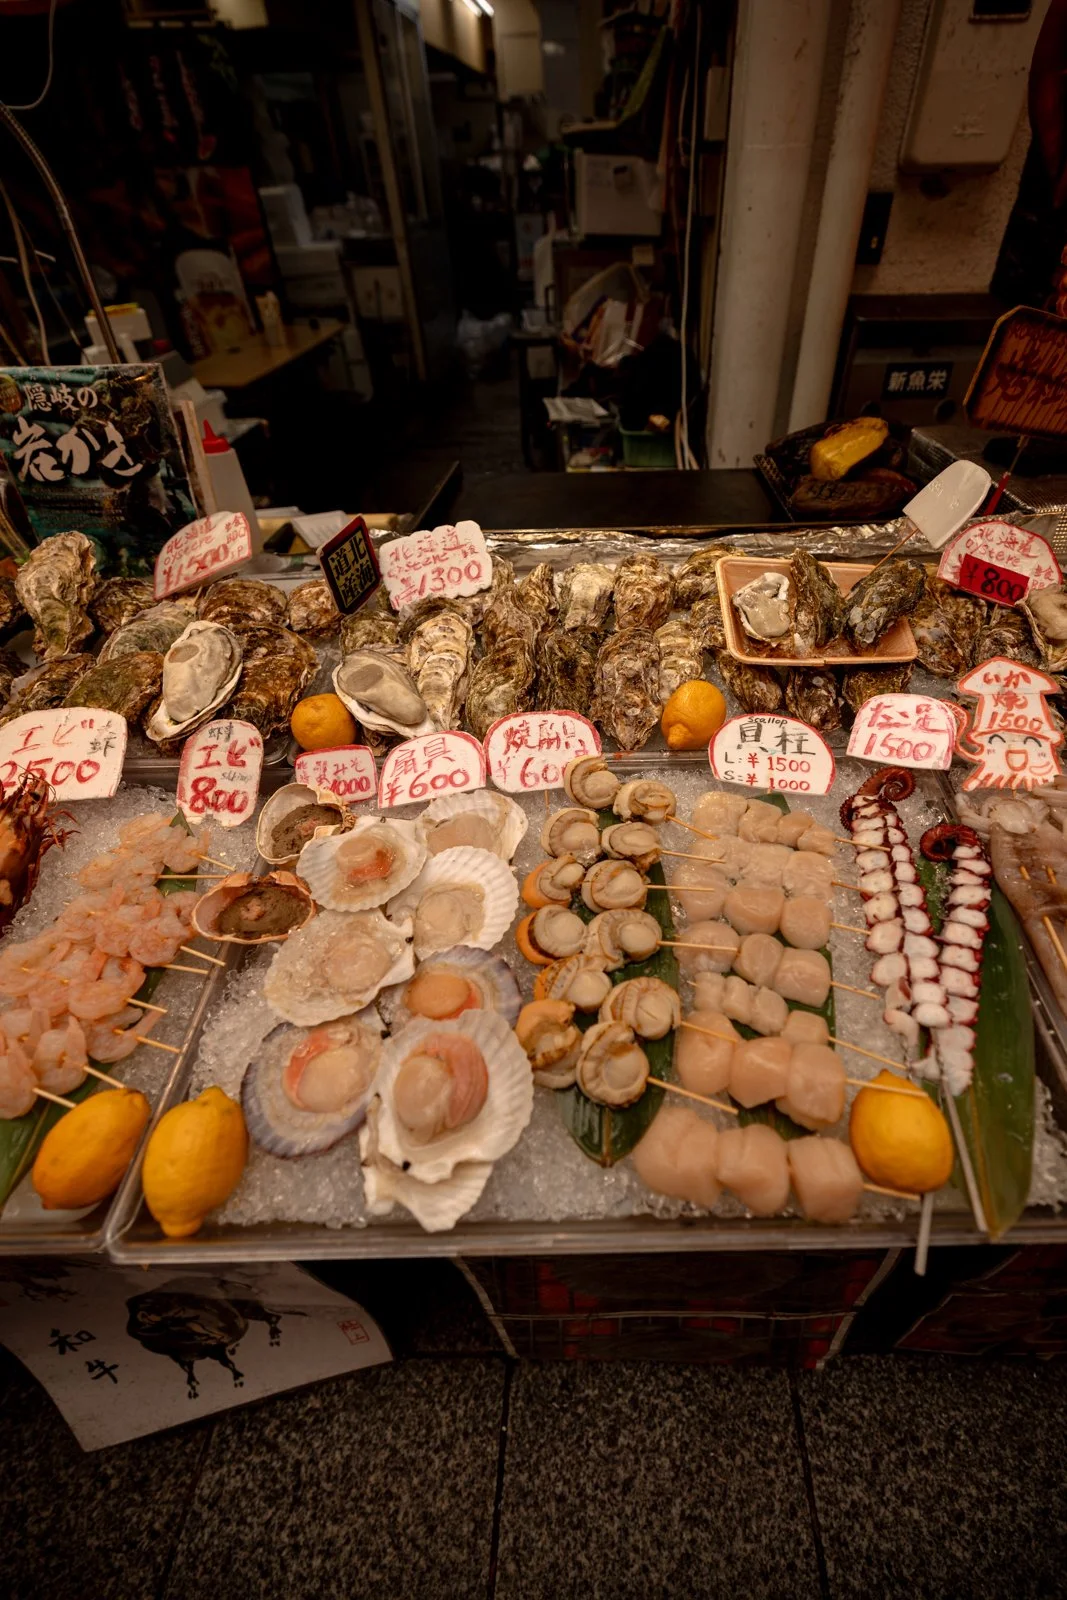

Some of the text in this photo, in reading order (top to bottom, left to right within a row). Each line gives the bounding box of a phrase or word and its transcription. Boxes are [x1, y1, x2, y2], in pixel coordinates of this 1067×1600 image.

[887, 368, 948, 392] 新魚栄
[23, 382, 98, 412] 隠岐の
[983, 671, 1031, 688] いか
[987, 711, 1042, 732] 1500
[195, 737, 262, 770] エビ
[737, 722, 816, 755] 貝柱
[864, 732, 937, 762] 1500
[384, 768, 470, 807] ¥600
[497, 756, 570, 788] ¥60
[189, 776, 249, 814] 800
